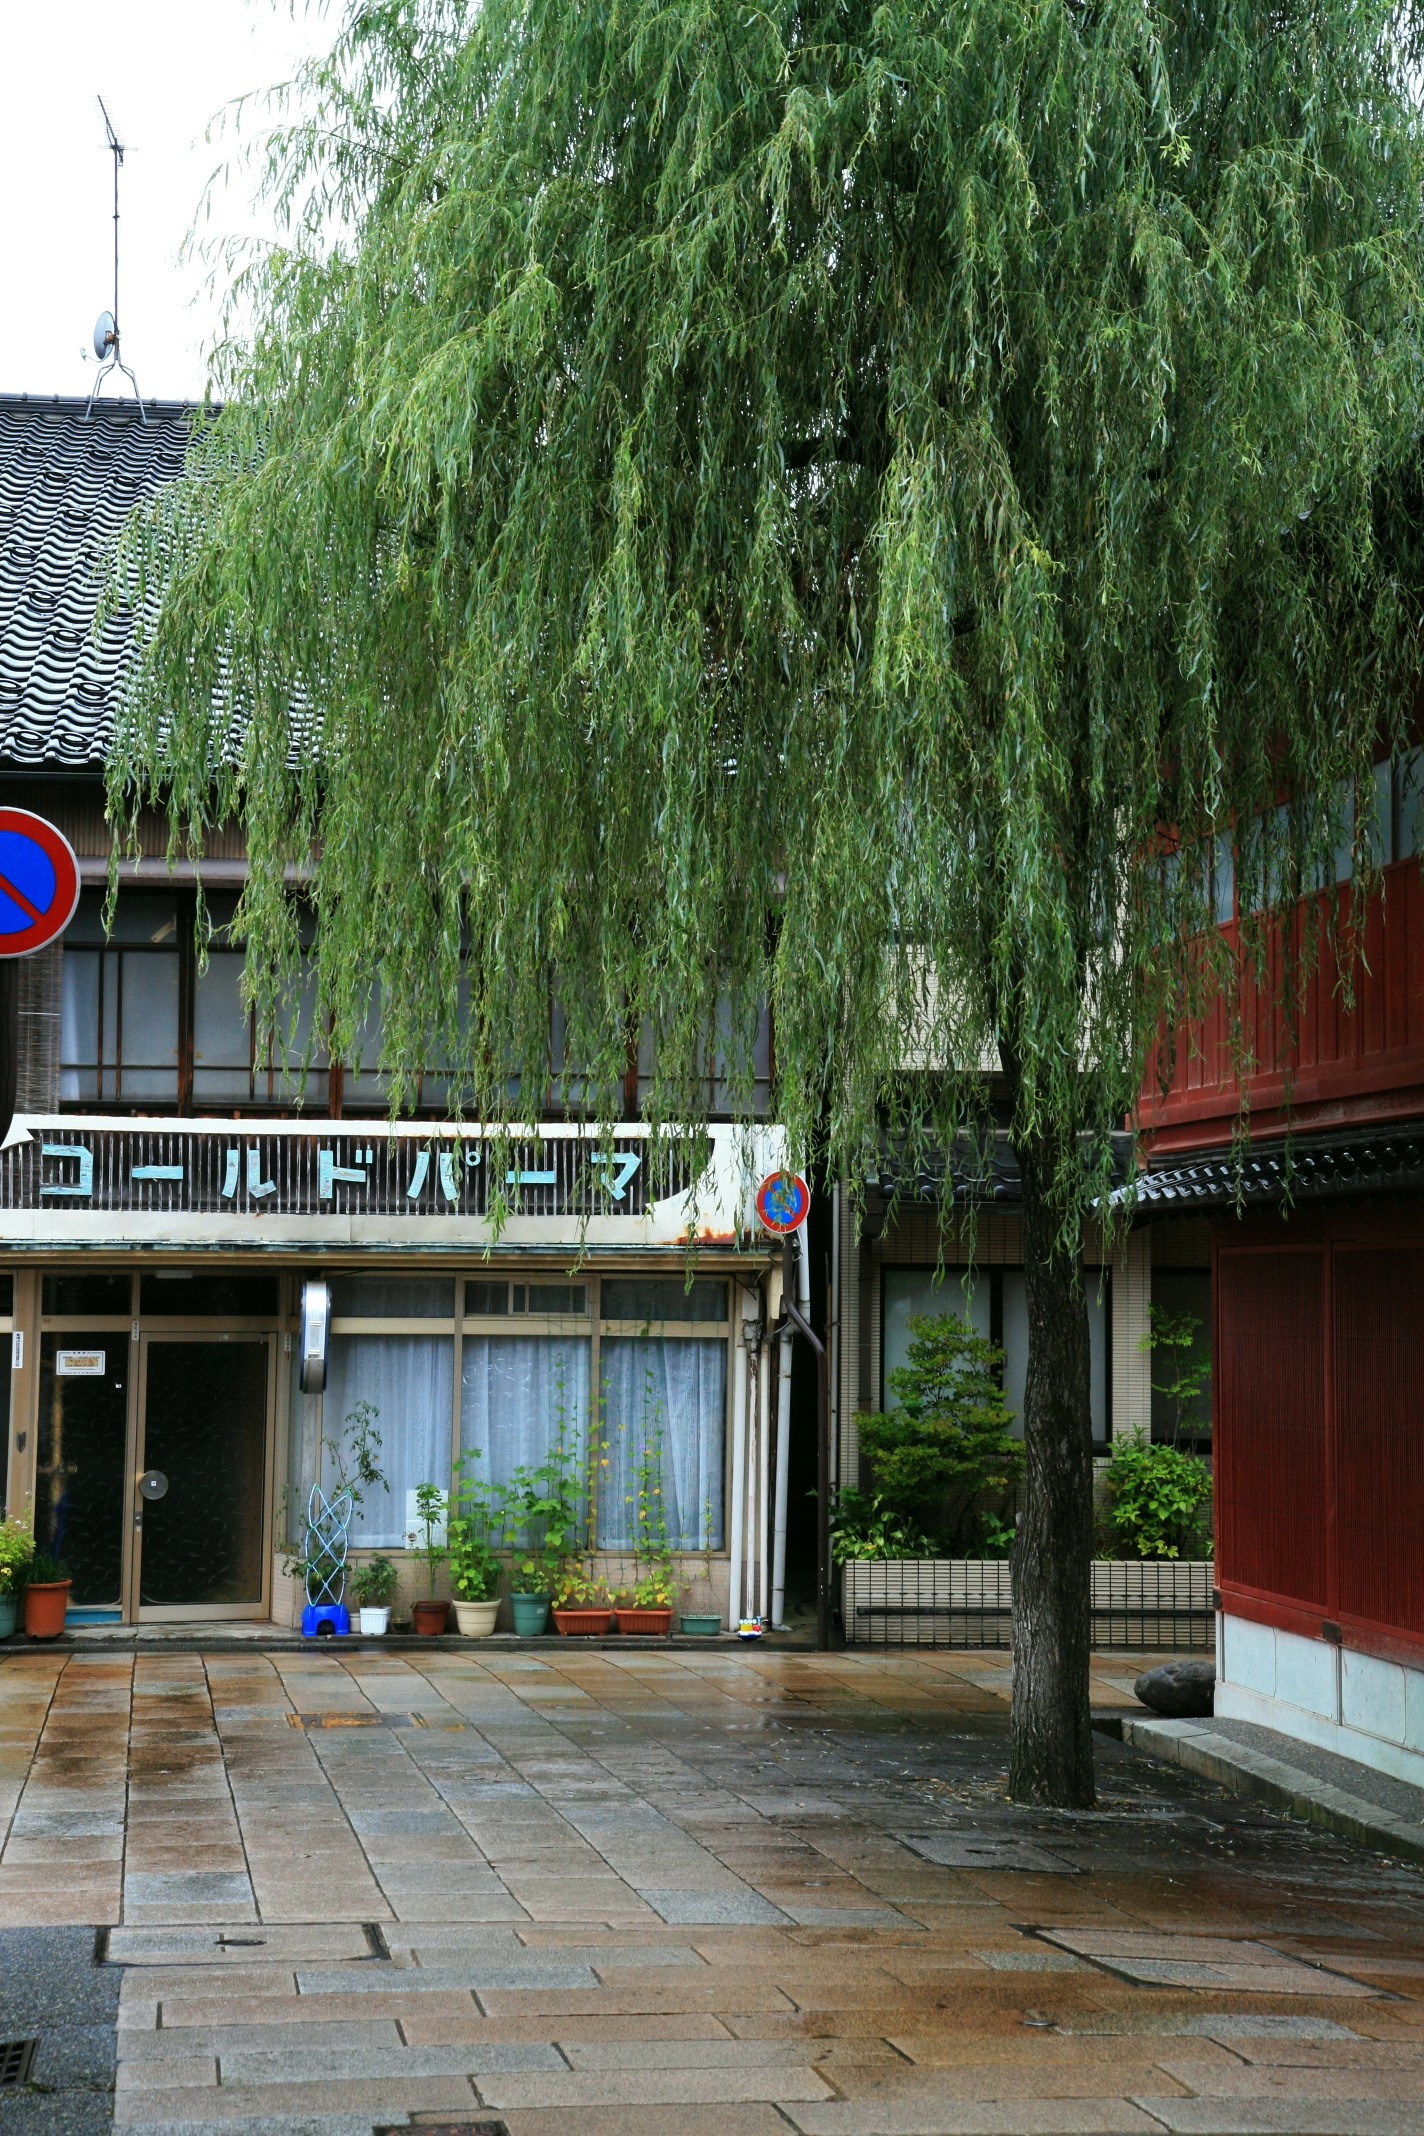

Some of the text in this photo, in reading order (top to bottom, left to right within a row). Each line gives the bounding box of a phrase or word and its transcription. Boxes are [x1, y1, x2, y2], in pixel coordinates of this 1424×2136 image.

[39, 1143, 642, 1201] コールドパーマ
